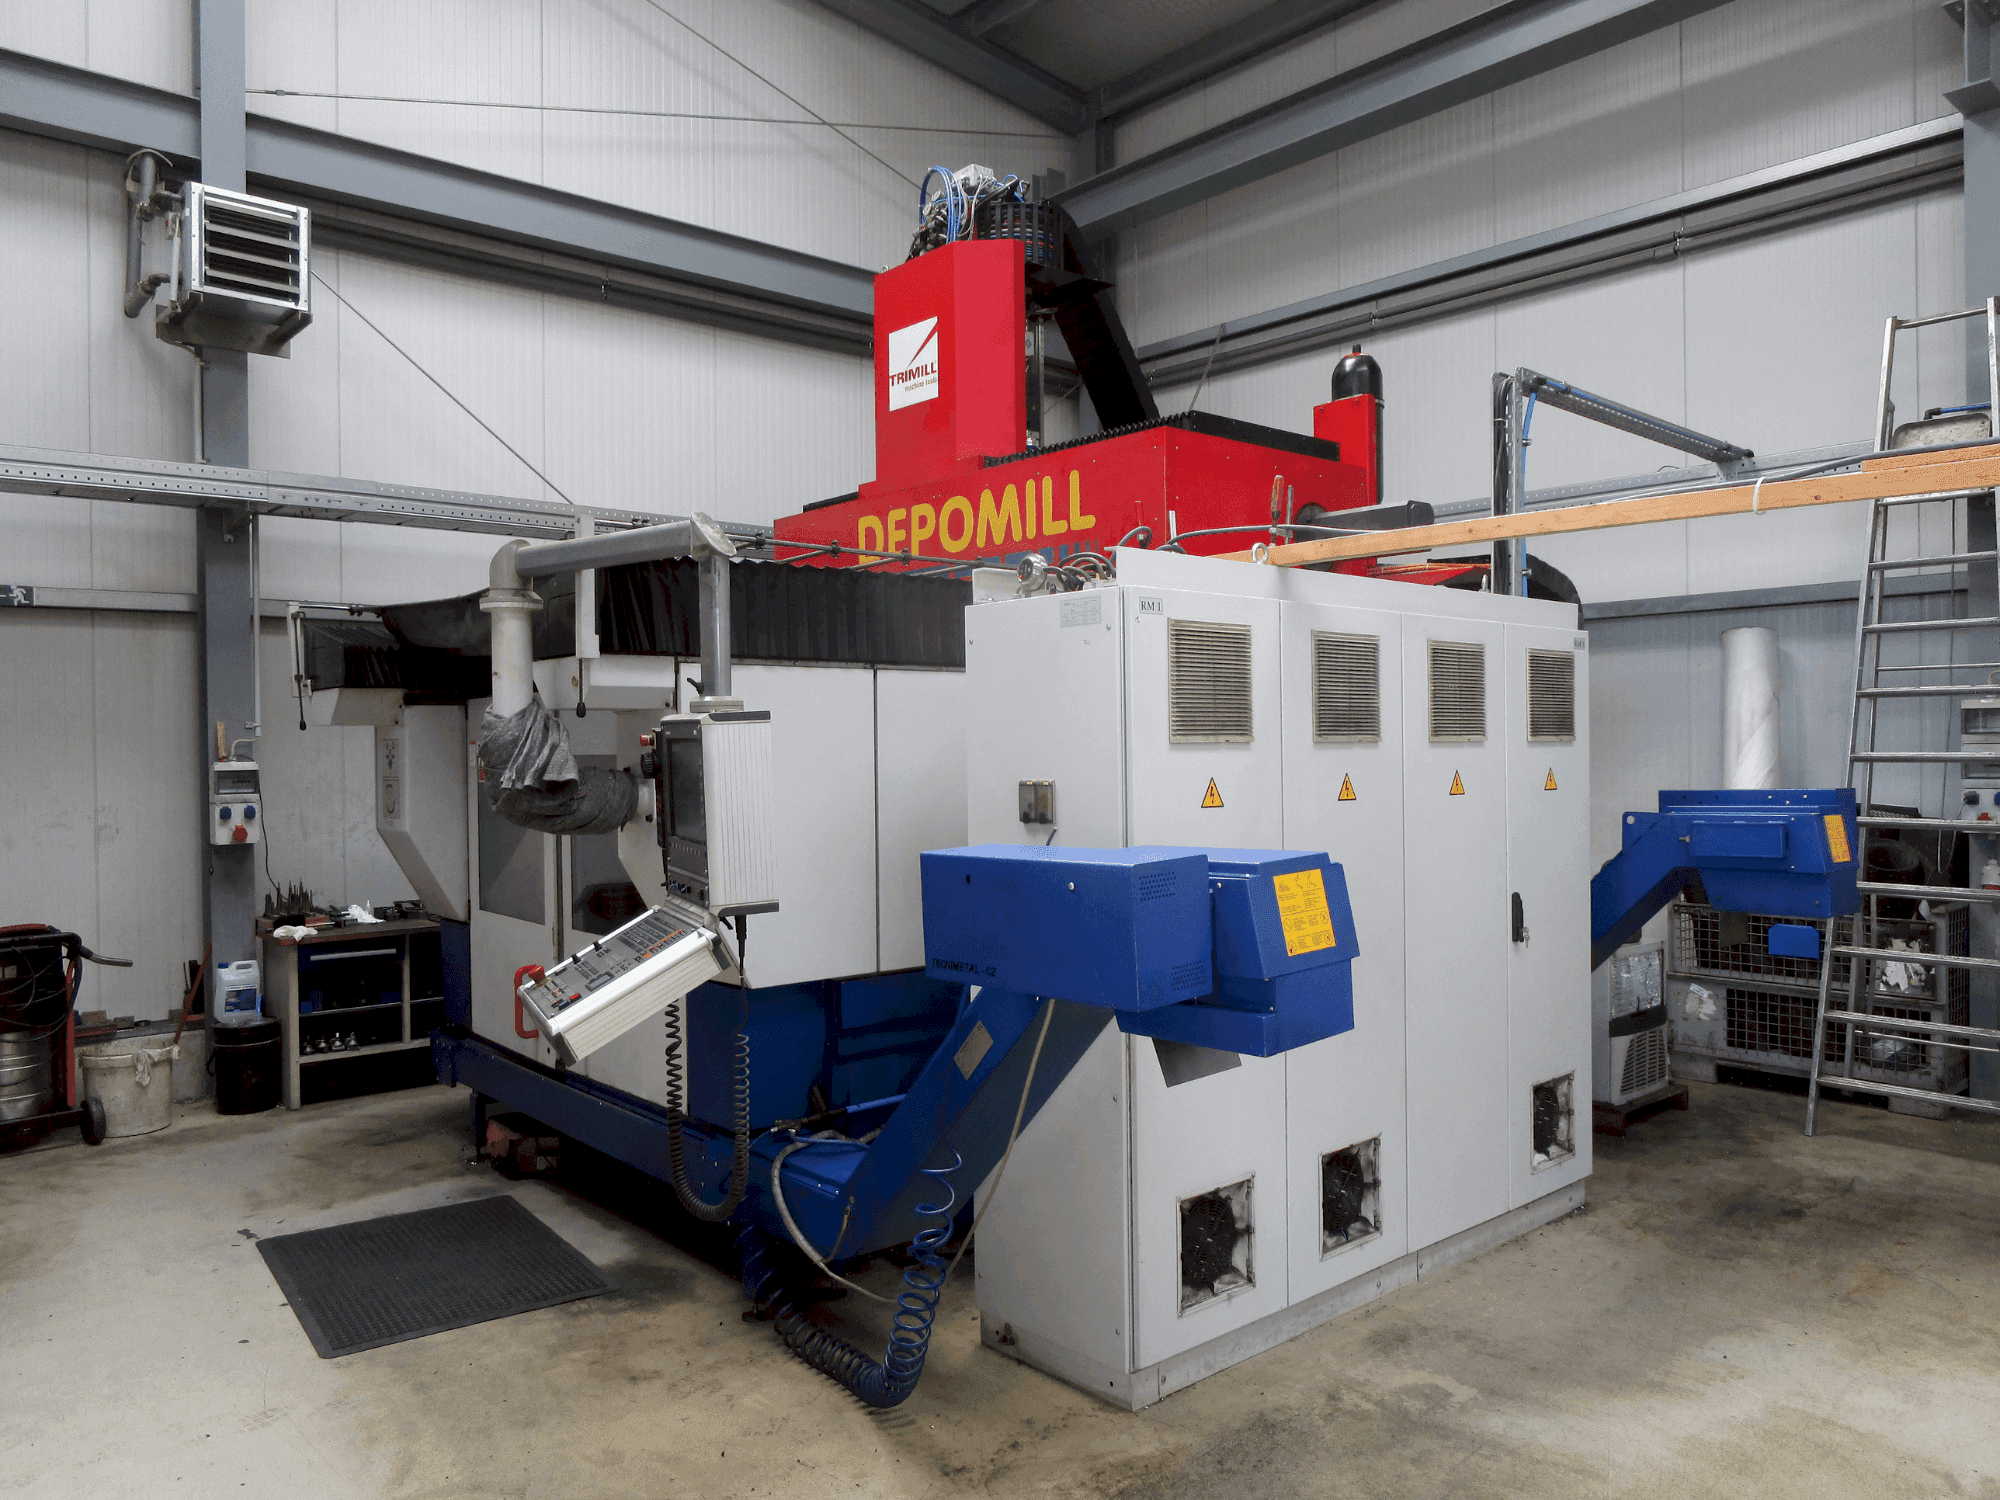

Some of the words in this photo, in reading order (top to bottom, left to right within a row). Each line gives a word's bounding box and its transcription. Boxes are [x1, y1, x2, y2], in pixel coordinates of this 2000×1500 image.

[888, 362, 937, 387] TRIMILL
[905, 380, 925, 392] machine
[926, 376, 938, 386] tools
[858, 470, 1096, 565] DEPOMILL
[1141, 601, 1155, 611] RM
